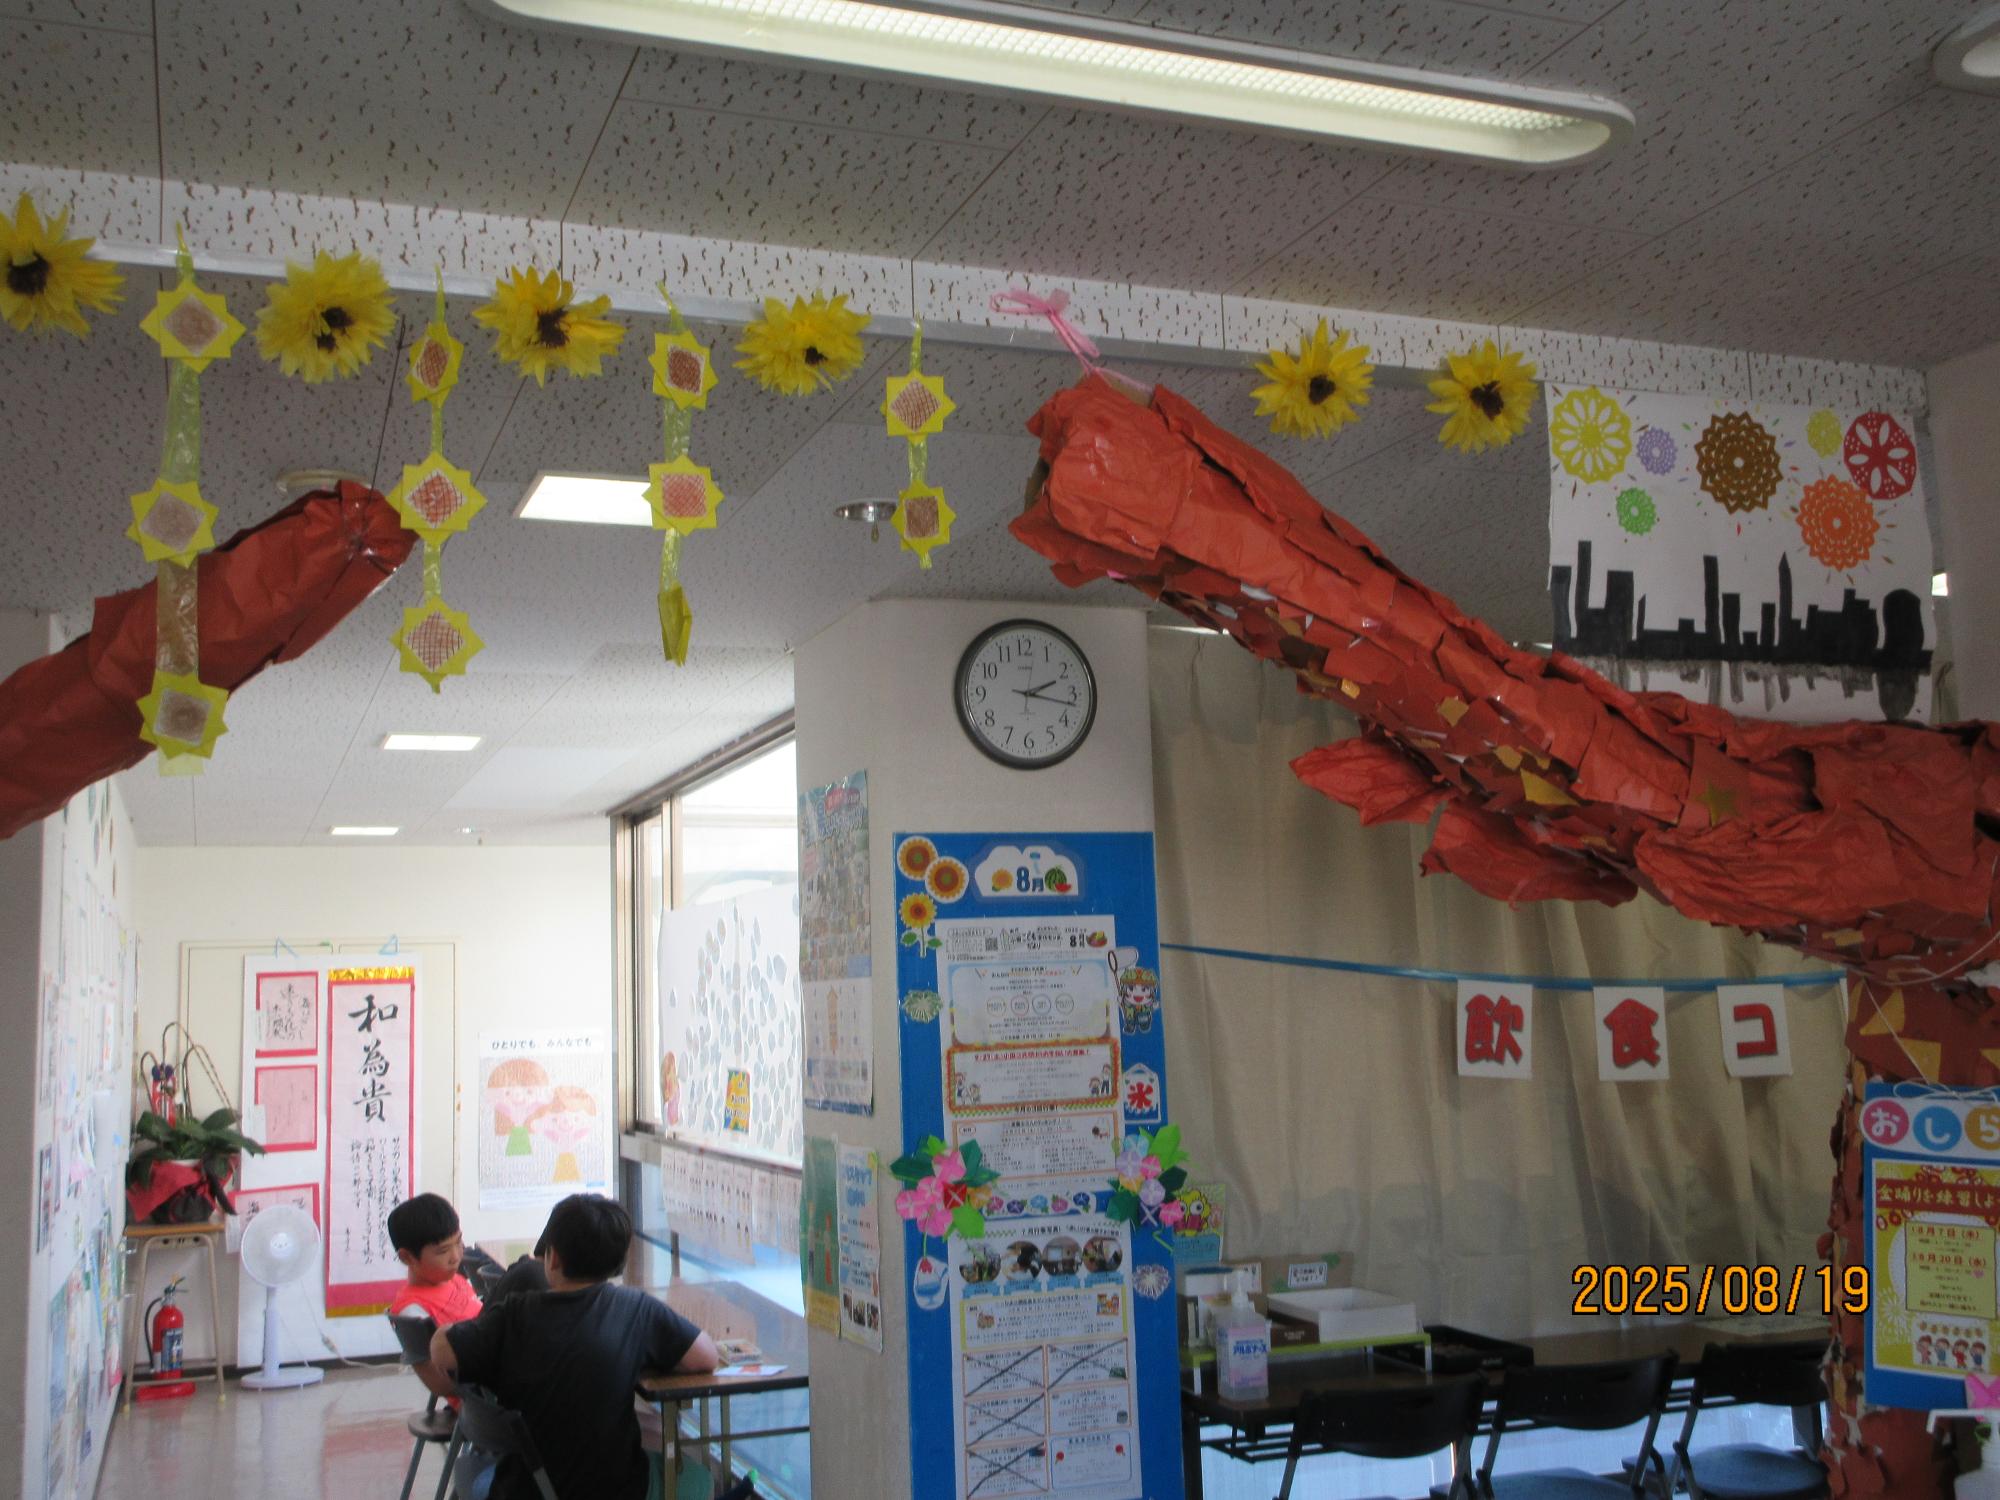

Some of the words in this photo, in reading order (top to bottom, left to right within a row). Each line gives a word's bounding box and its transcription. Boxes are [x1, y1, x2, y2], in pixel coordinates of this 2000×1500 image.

[998, 645, 1011, 662] 11
[1017, 639, 1033, 656] 12
[982, 662, 998, 679] 10
[1059, 662, 1069, 679] 2
[975, 685, 987, 703] 9
[1067, 685, 1077, 703] 3
[984, 709, 995, 727] 8
[1058, 709, 1069, 728] 4
[1003, 726, 1014, 744] 7
[1023, 731, 1034, 749] 6
[1046, 726, 1055, 744] 5
[1016, 865, 1045, 892] 8月
[348, 994, 399, 1123] 和為貴
